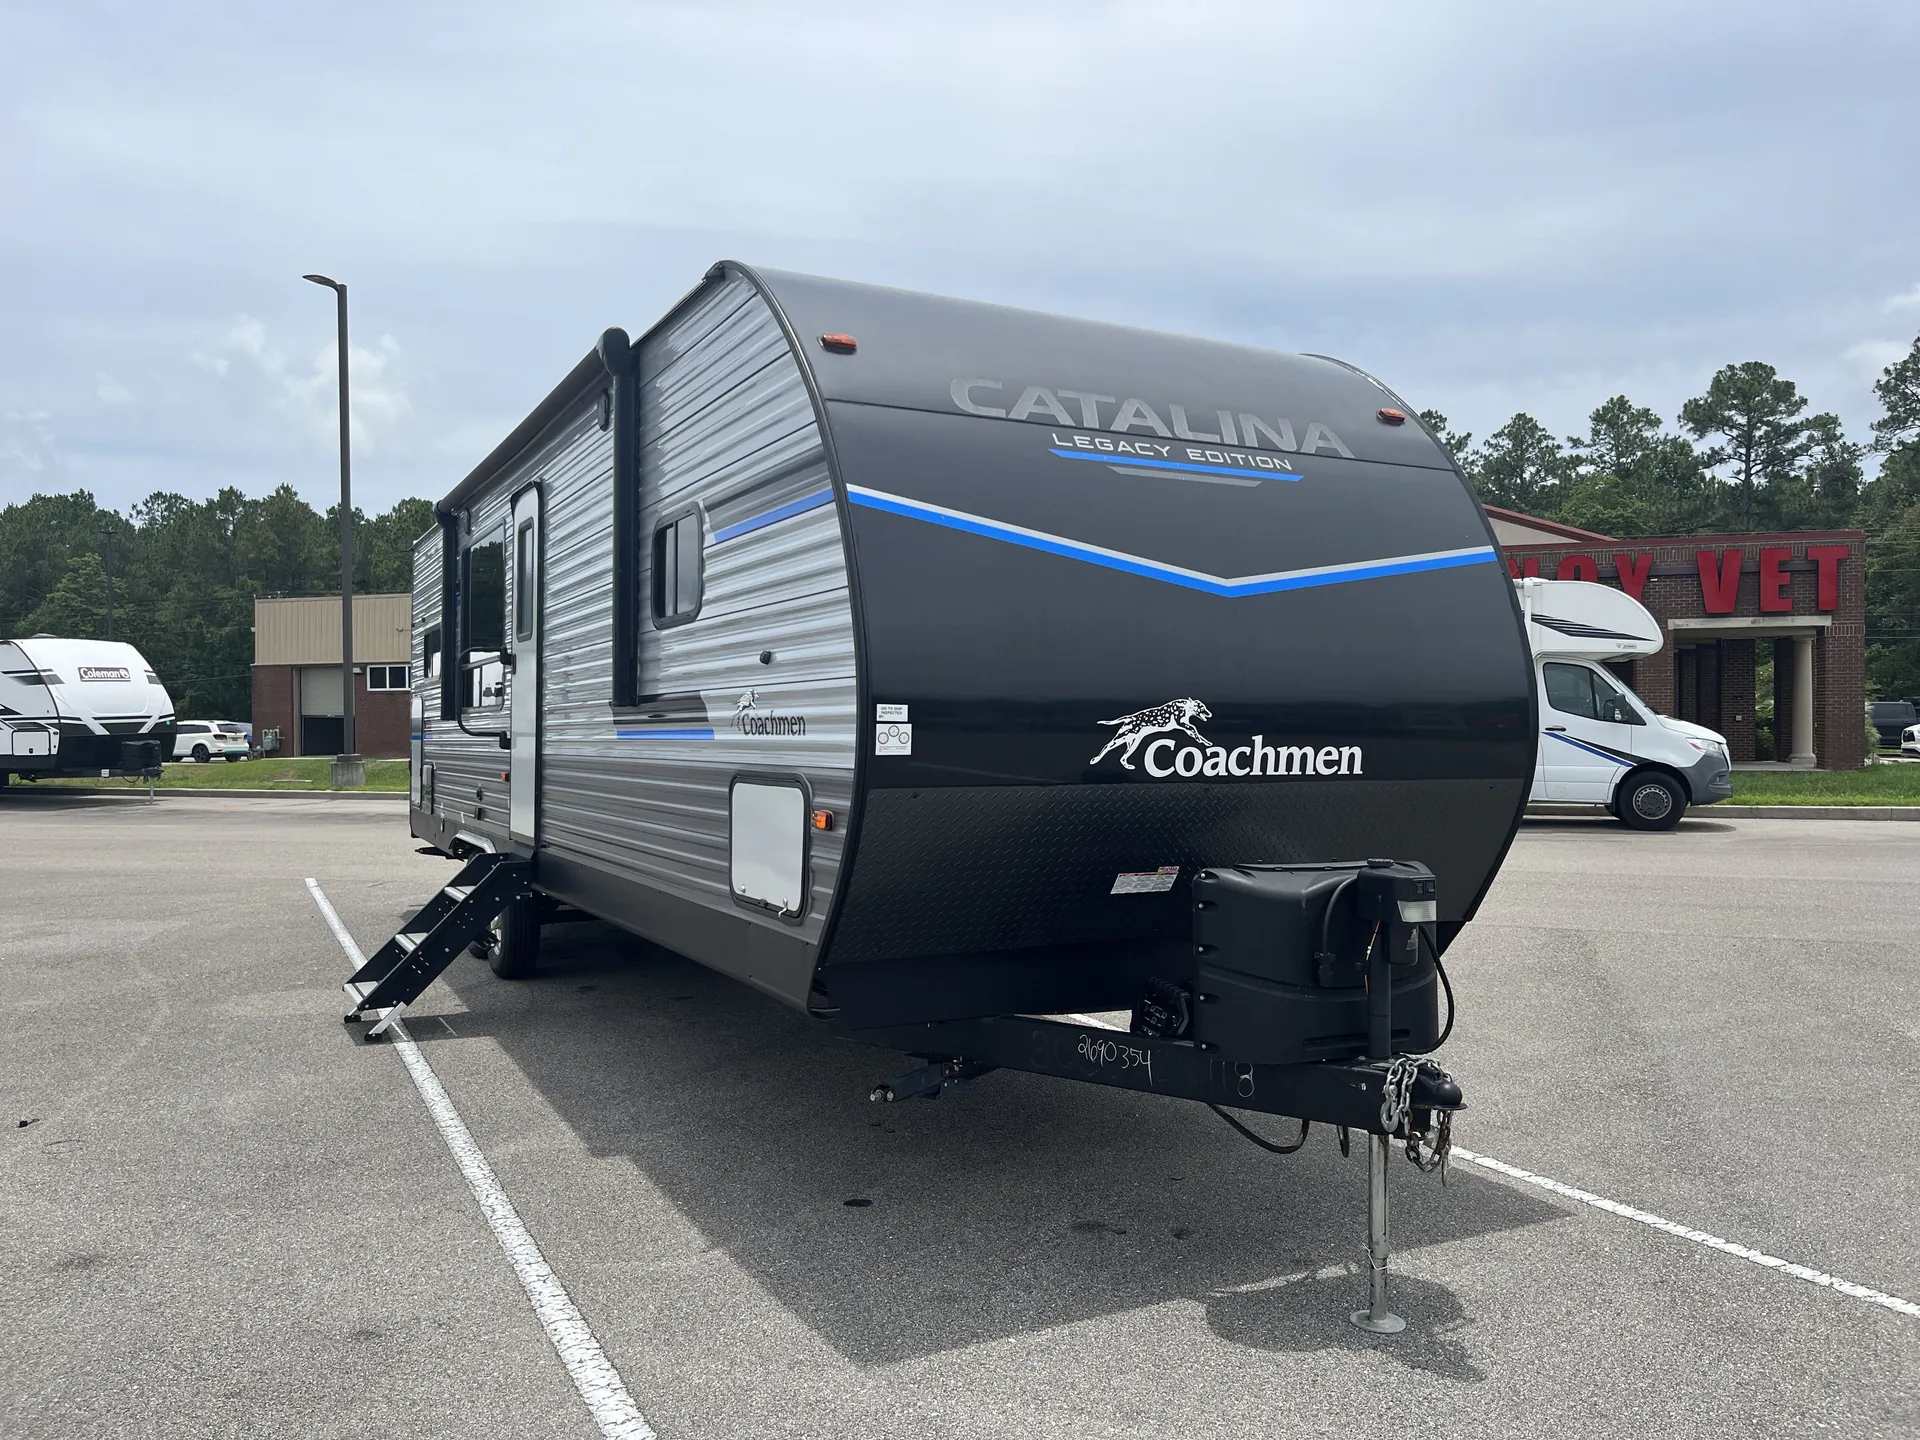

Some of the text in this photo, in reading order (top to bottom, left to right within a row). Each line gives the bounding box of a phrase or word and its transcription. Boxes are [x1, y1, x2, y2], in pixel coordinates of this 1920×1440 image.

[949, 376, 1357, 459] CATALINA
[1052, 432, 1293, 471] LEGACY EDITION
[1696, 545, 1850, 614] VET
[80, 668, 120, 678] Coleman
[741, 709, 806, 736] Coachmen
[1143, 734, 1364, 778] Coachmen
[1077, 1033, 1154, 1088] 2690354
